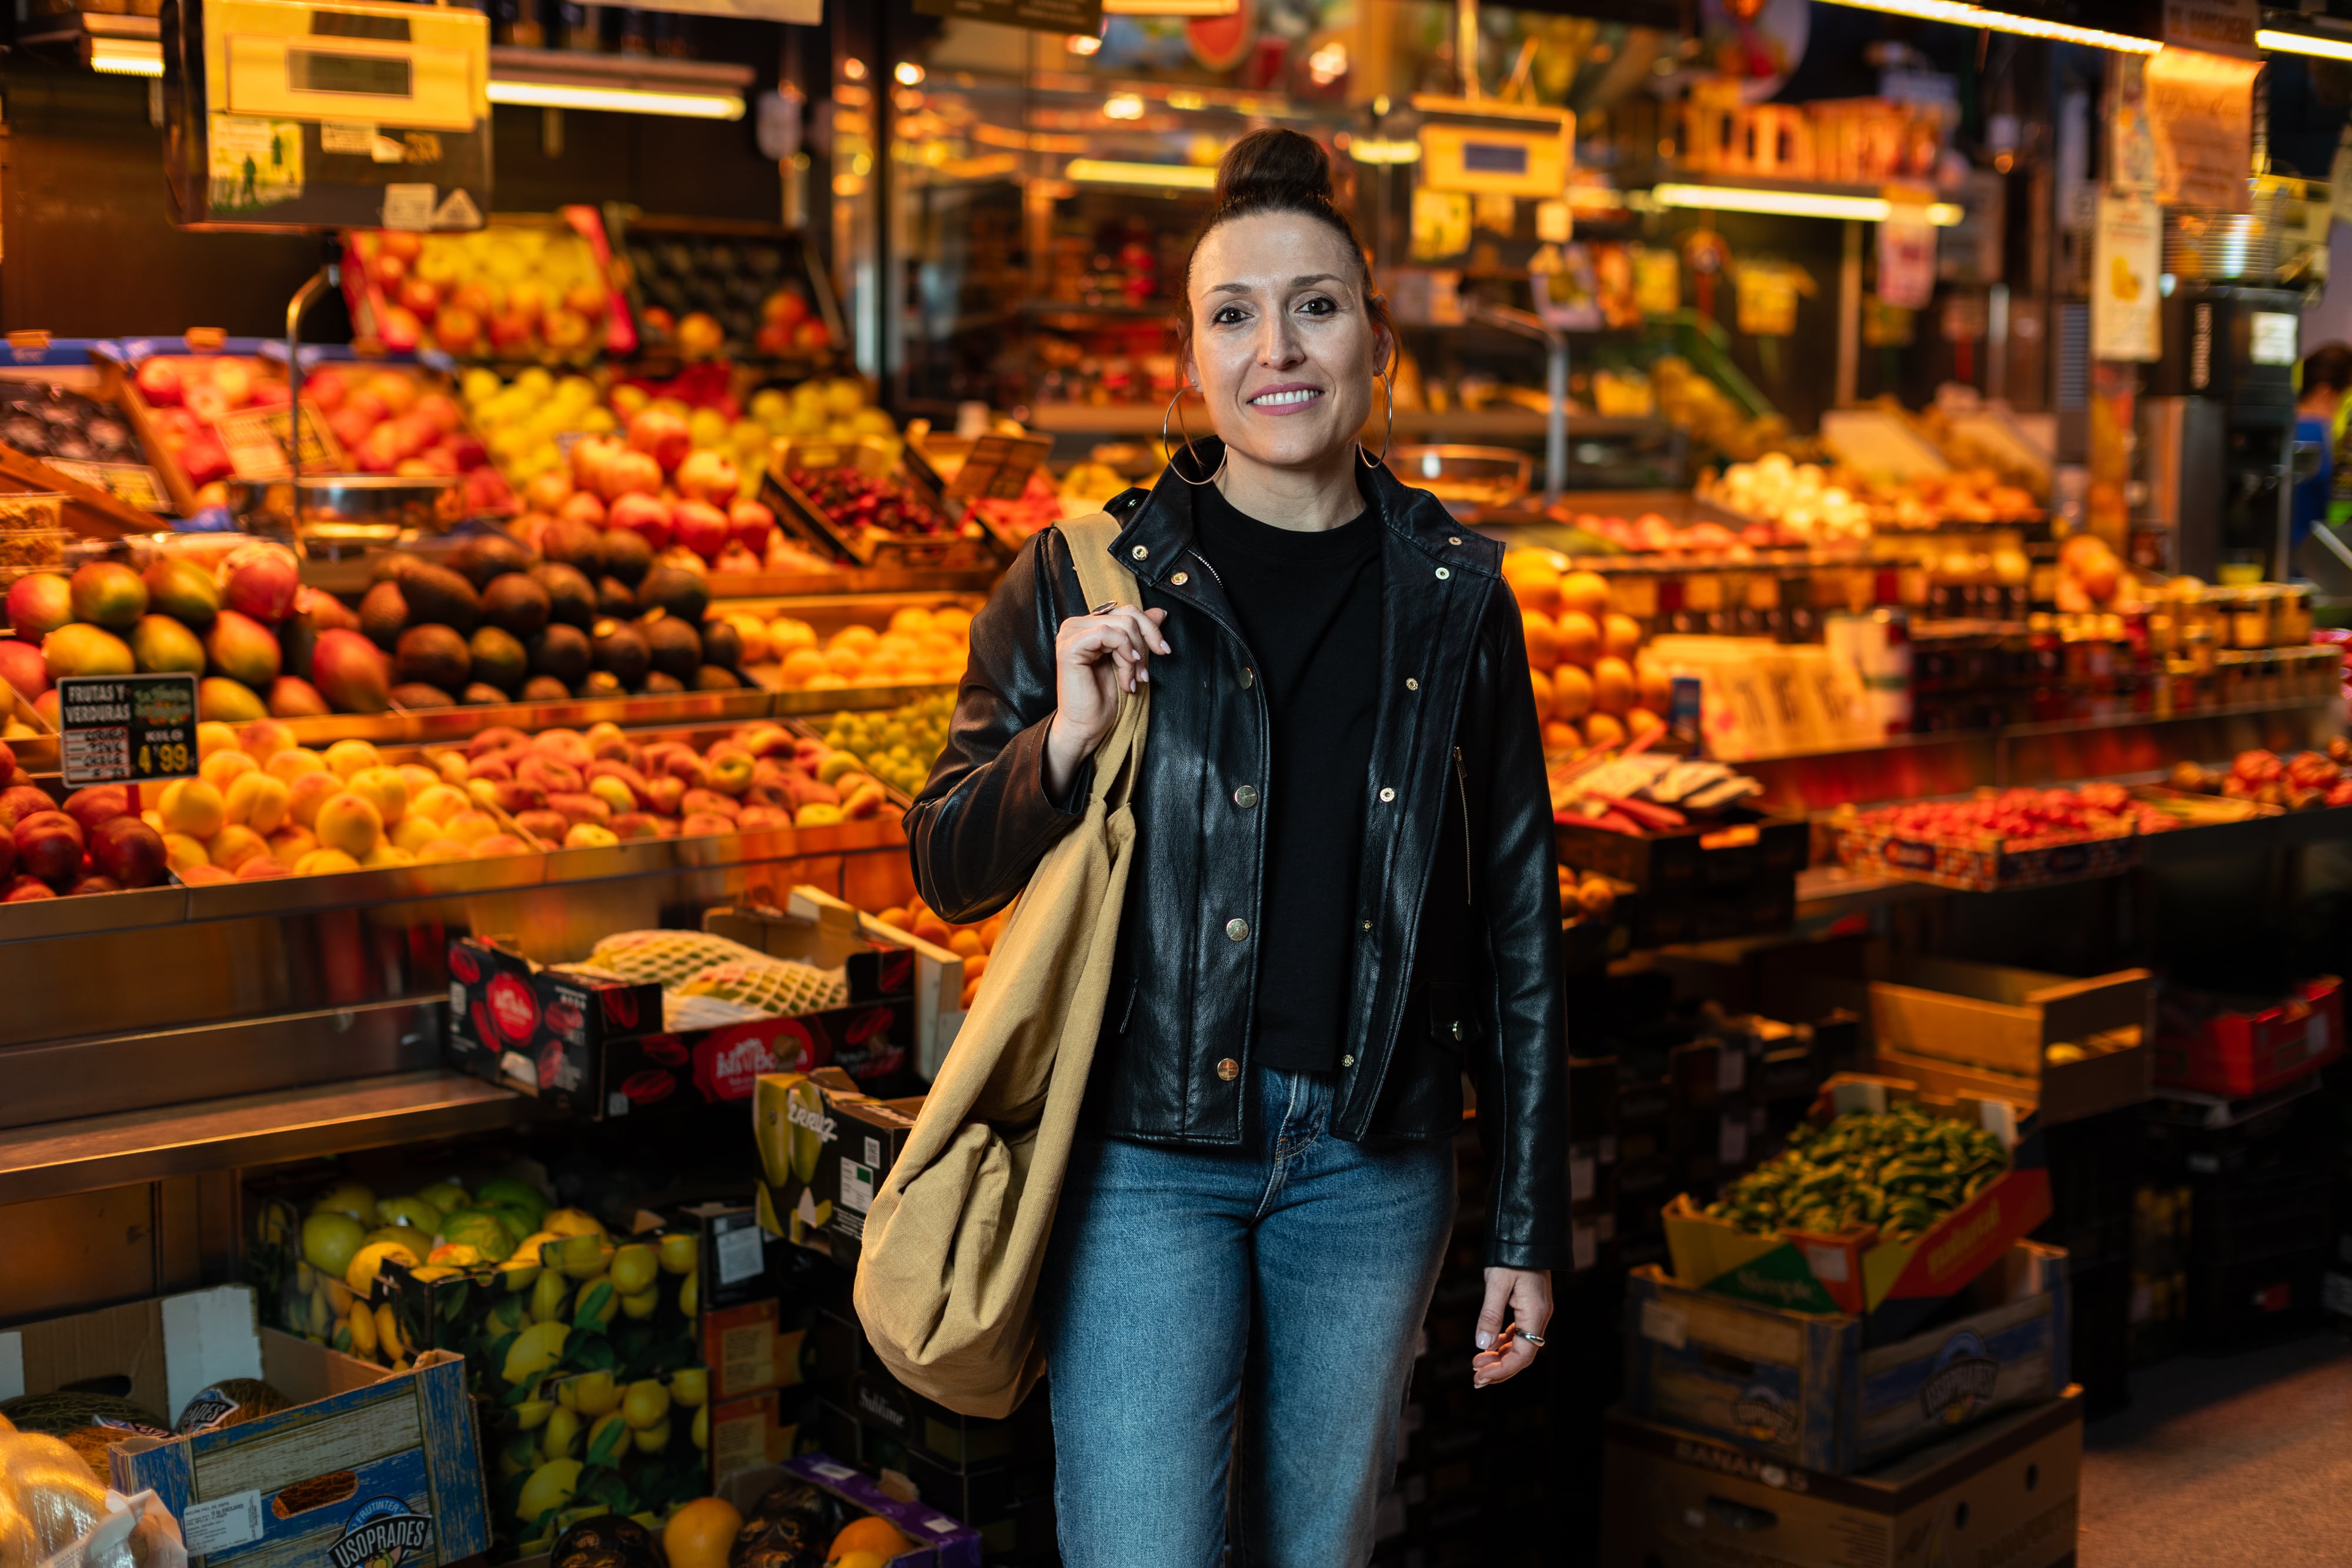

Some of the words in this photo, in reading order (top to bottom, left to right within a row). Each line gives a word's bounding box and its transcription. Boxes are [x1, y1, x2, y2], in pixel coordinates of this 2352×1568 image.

[68, 684, 115, 703] FRUTAS
[115, 683, 126, 701] Y
[65, 704, 131, 724] VERDURAS
[145, 728, 185, 743] KILO
[356, 1500, 400, 1523] FRUTINTER
[335, 1520, 425, 1568] USOPRADES
